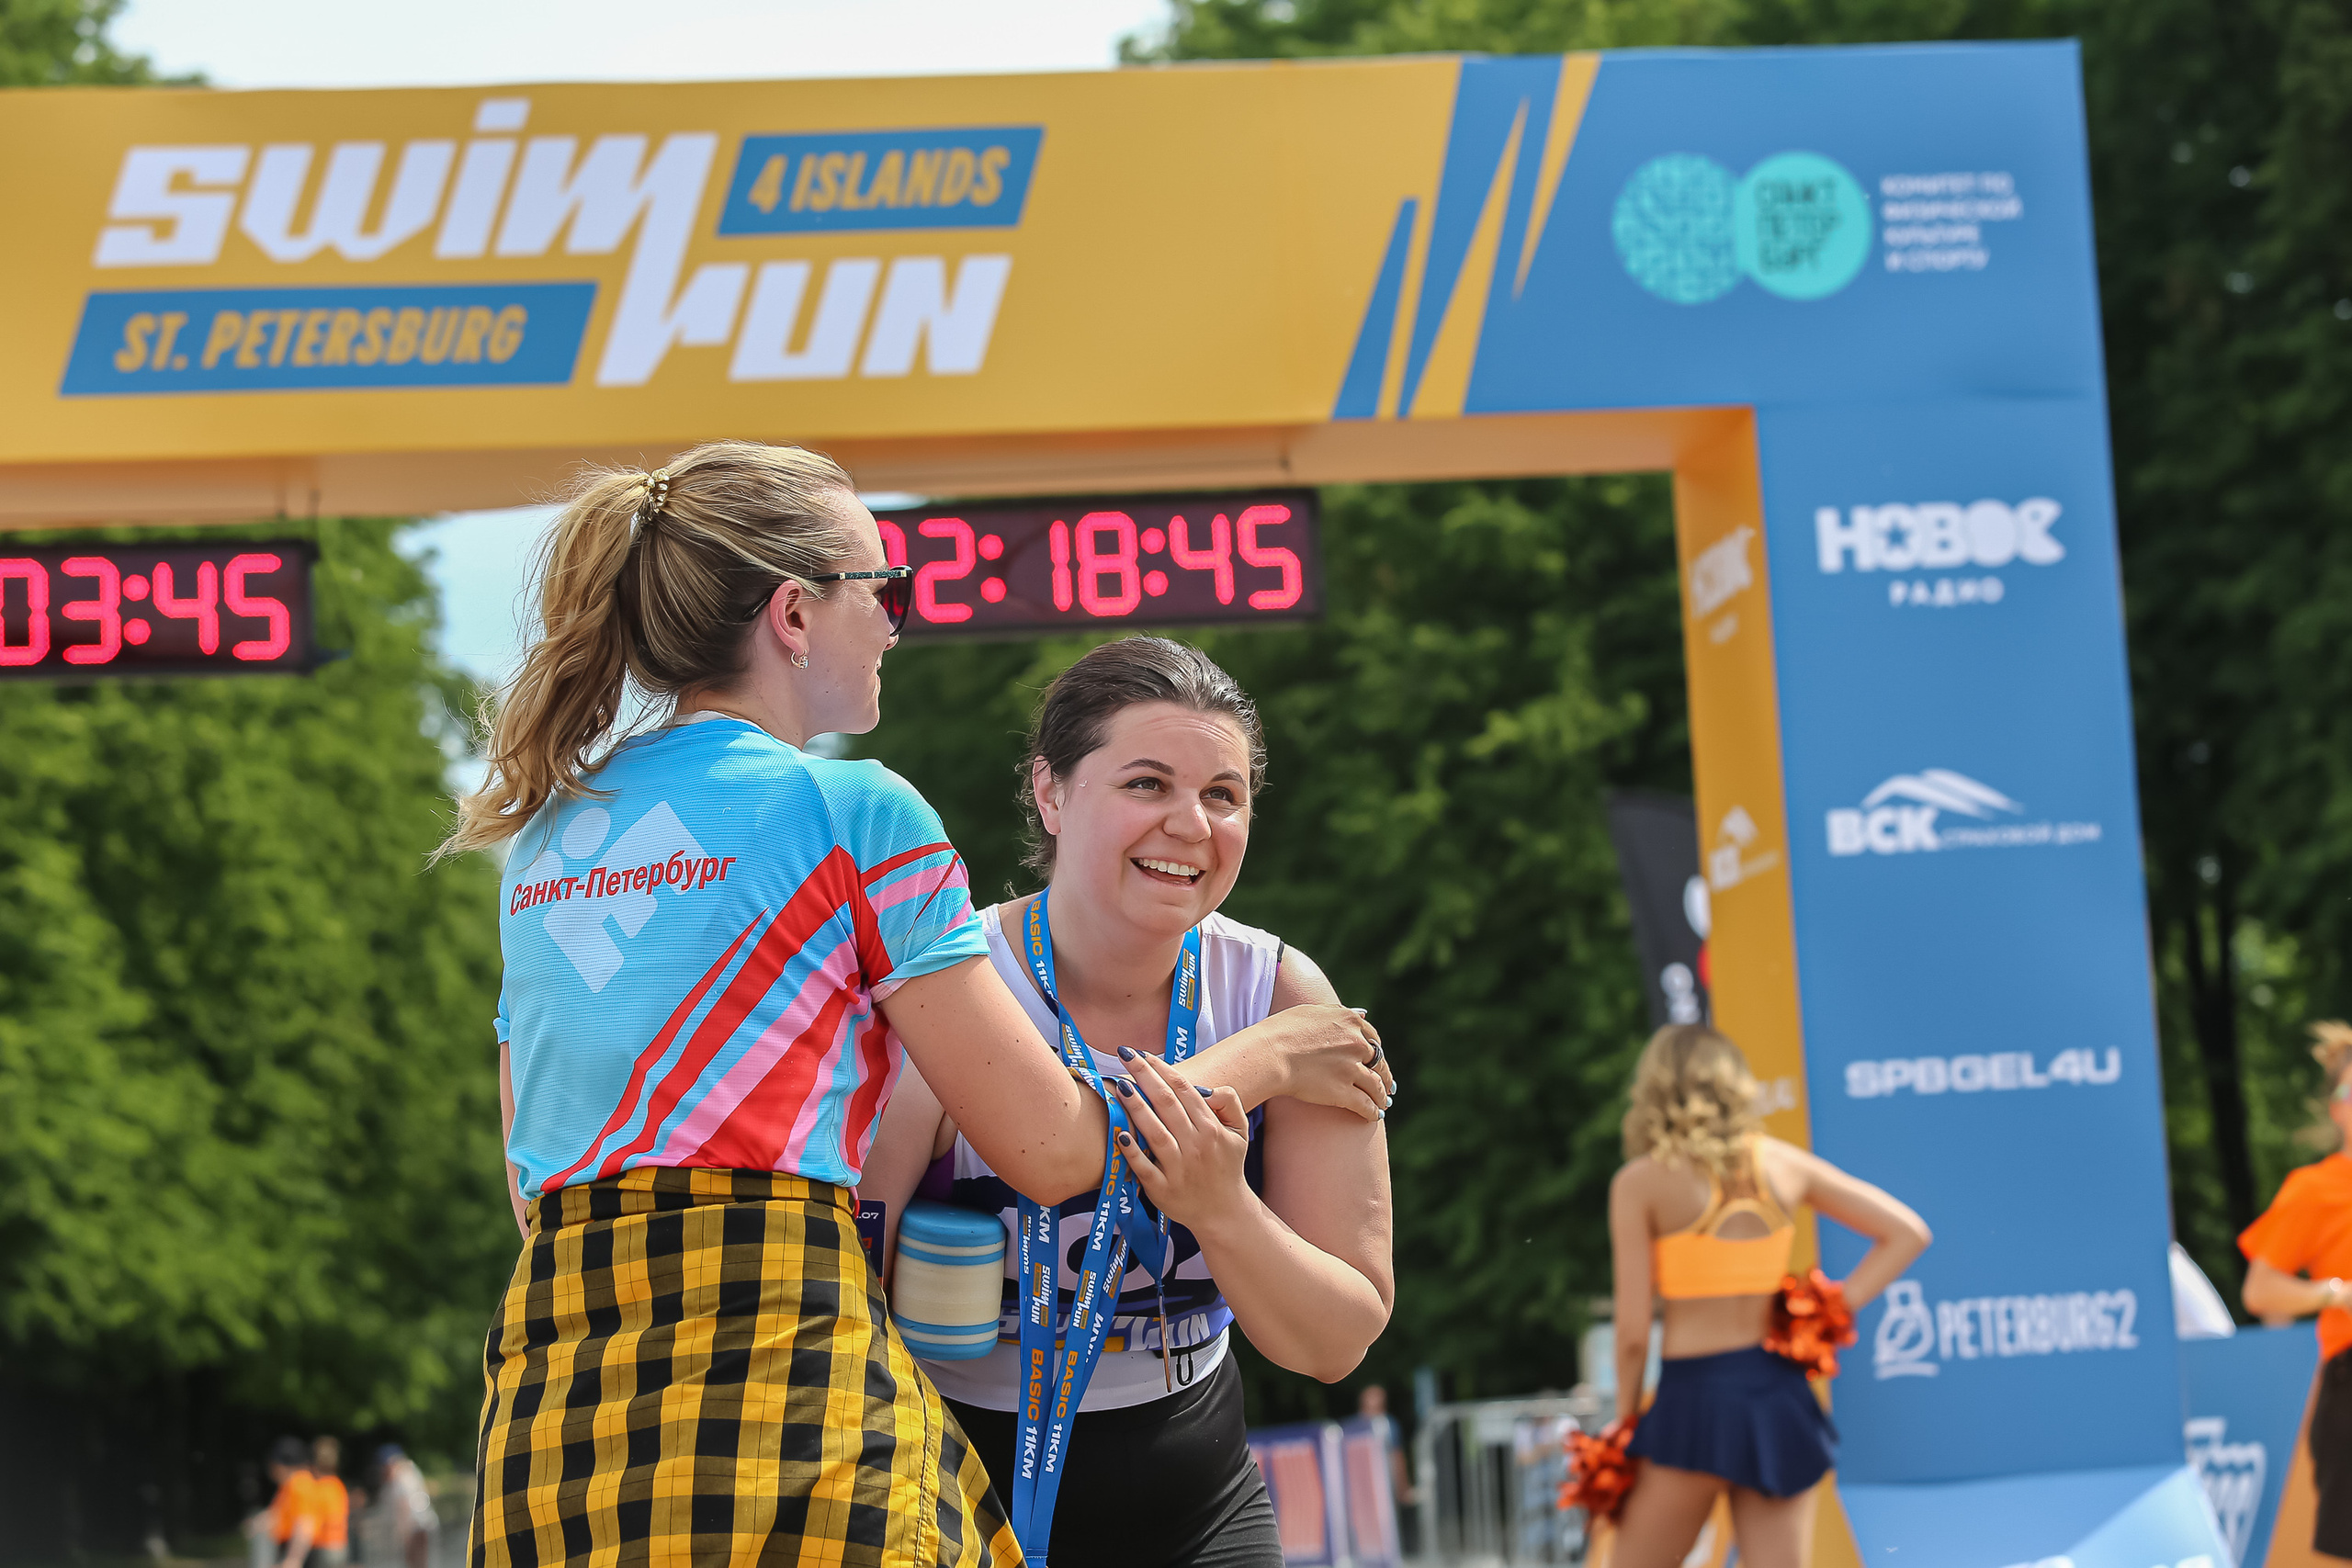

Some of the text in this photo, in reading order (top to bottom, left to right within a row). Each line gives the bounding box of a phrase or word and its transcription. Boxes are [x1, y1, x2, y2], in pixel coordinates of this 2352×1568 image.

[748, 145, 1009, 213] 4 ISLANDS
[114, 305, 528, 372] ST. PETERSBURG
[0, 553, 290, 666] 03:45
[1888, 577, 2006, 608] РАДИО
[509, 850, 737, 917] Санкт-Петербург
[1030, 899, 1044, 956] BASIC
[1173, 1025, 1189, 1066] KM
[1845, 1046, 2121, 1099] SPBGEL4U
[1039, 1205, 1051, 1244] KM
[1092, 1201, 1111, 1251] 11KM
[1937, 1290, 2140, 1361] PETERBURG2
[1022, 1348, 1044, 1480] BASIC 11KM
[1045, 1350, 1079, 1473] BASIC 11KM
